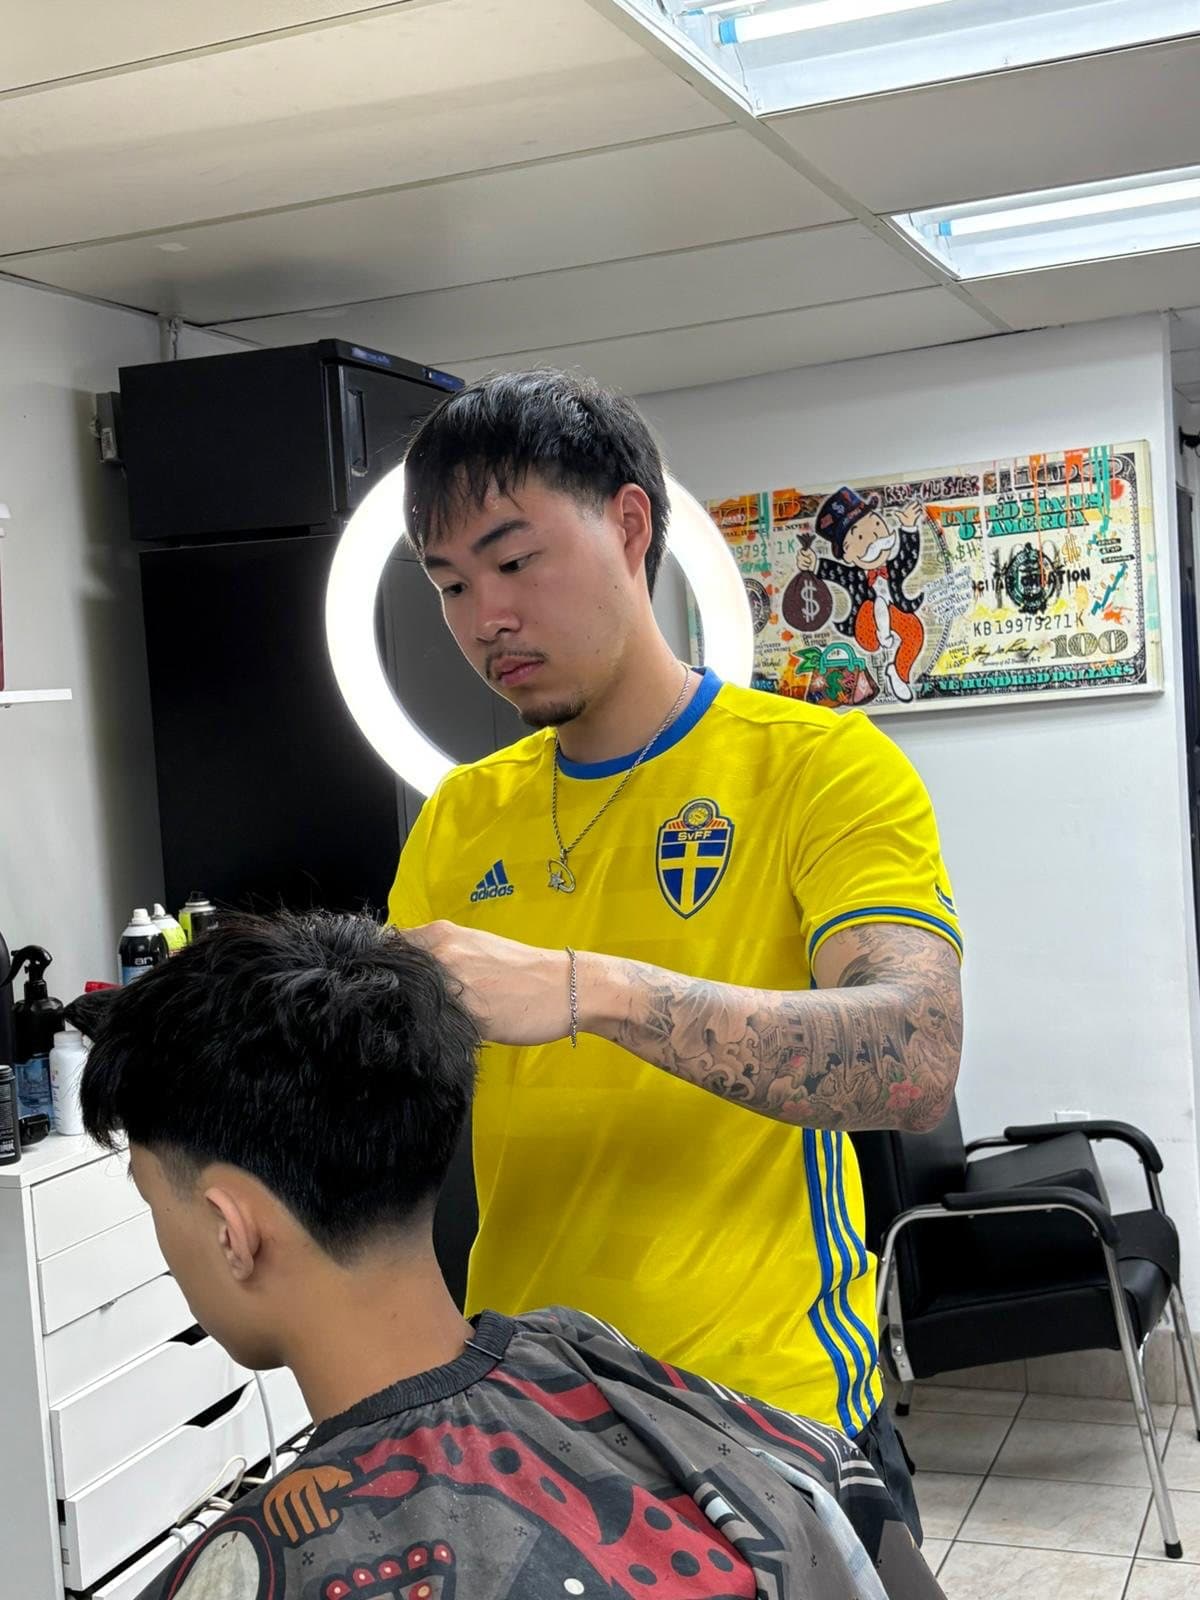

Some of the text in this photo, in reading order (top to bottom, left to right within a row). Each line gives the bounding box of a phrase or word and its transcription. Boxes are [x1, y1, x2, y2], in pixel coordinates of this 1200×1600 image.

[1050, 629, 1129, 659] 100
[1053, 664, 1135, 683] DOLLARS
[677, 830, 712, 841] SvFF
[470, 884, 514, 903] adidas
